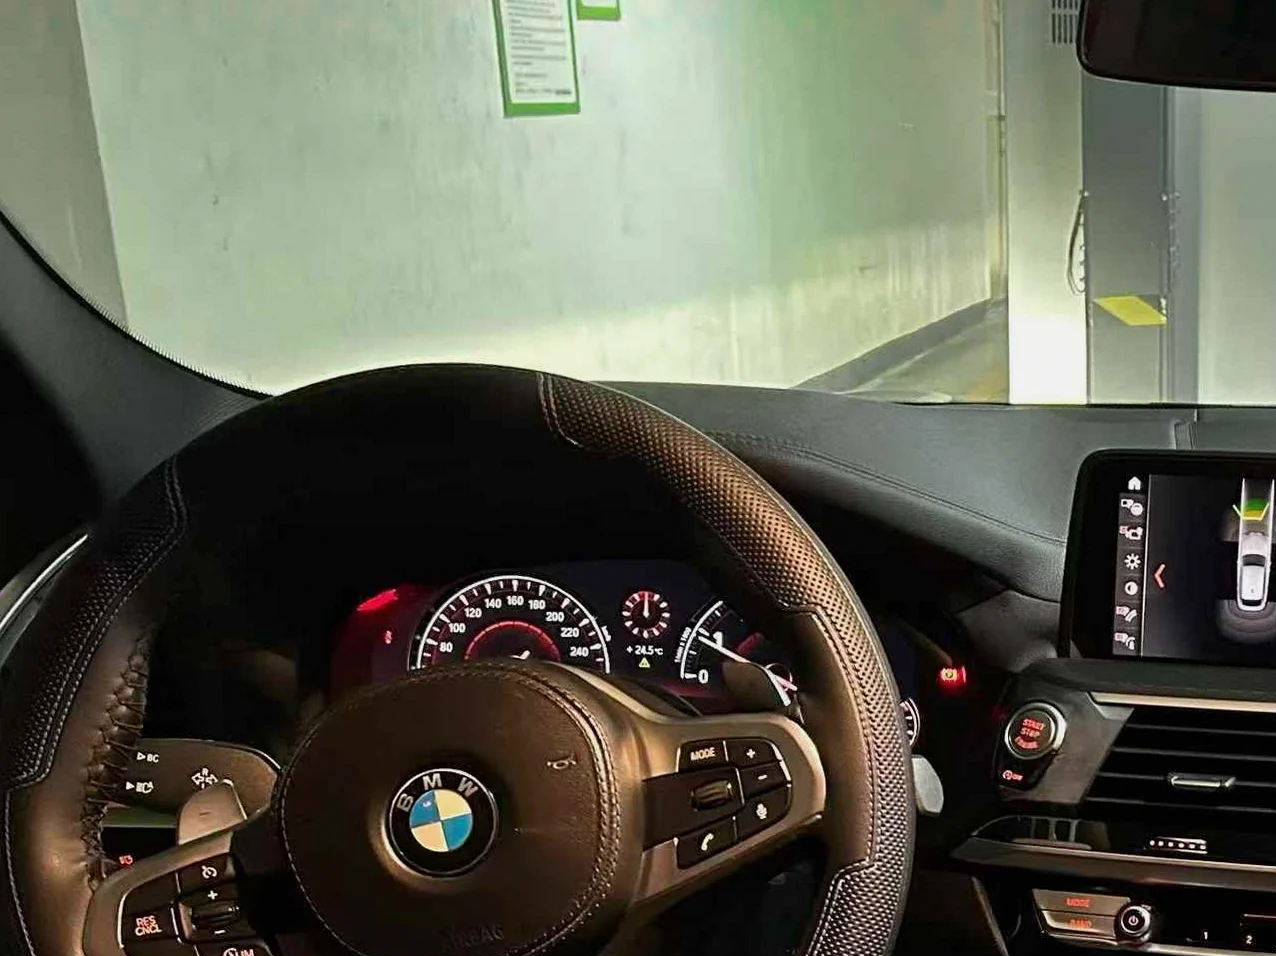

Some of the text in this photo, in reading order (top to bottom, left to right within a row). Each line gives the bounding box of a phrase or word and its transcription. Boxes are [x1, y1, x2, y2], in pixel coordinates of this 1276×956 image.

[484, 597, 502, 609] 140
[506, 594, 525, 606] 160
[528, 598, 546, 610] 180
[464, 606, 482, 619] 120
[545, 610, 565, 623] 200
[449, 622, 466, 634] 100
[560, 627, 580, 638] 220
[439, 642, 454, 653] 80
[569, 646, 589, 658] 240
[698, 669, 709, 684] 0
[147, 753, 160, 763] BC
[690, 747, 717, 761] MODE
[396, 772, 480, 813] BMW
[135, 915, 157, 927] RES
[134, 925, 163, 937] CNCL
[1203, 931, 1209, 940] 1
[1245, 935, 1252, 944] 2
